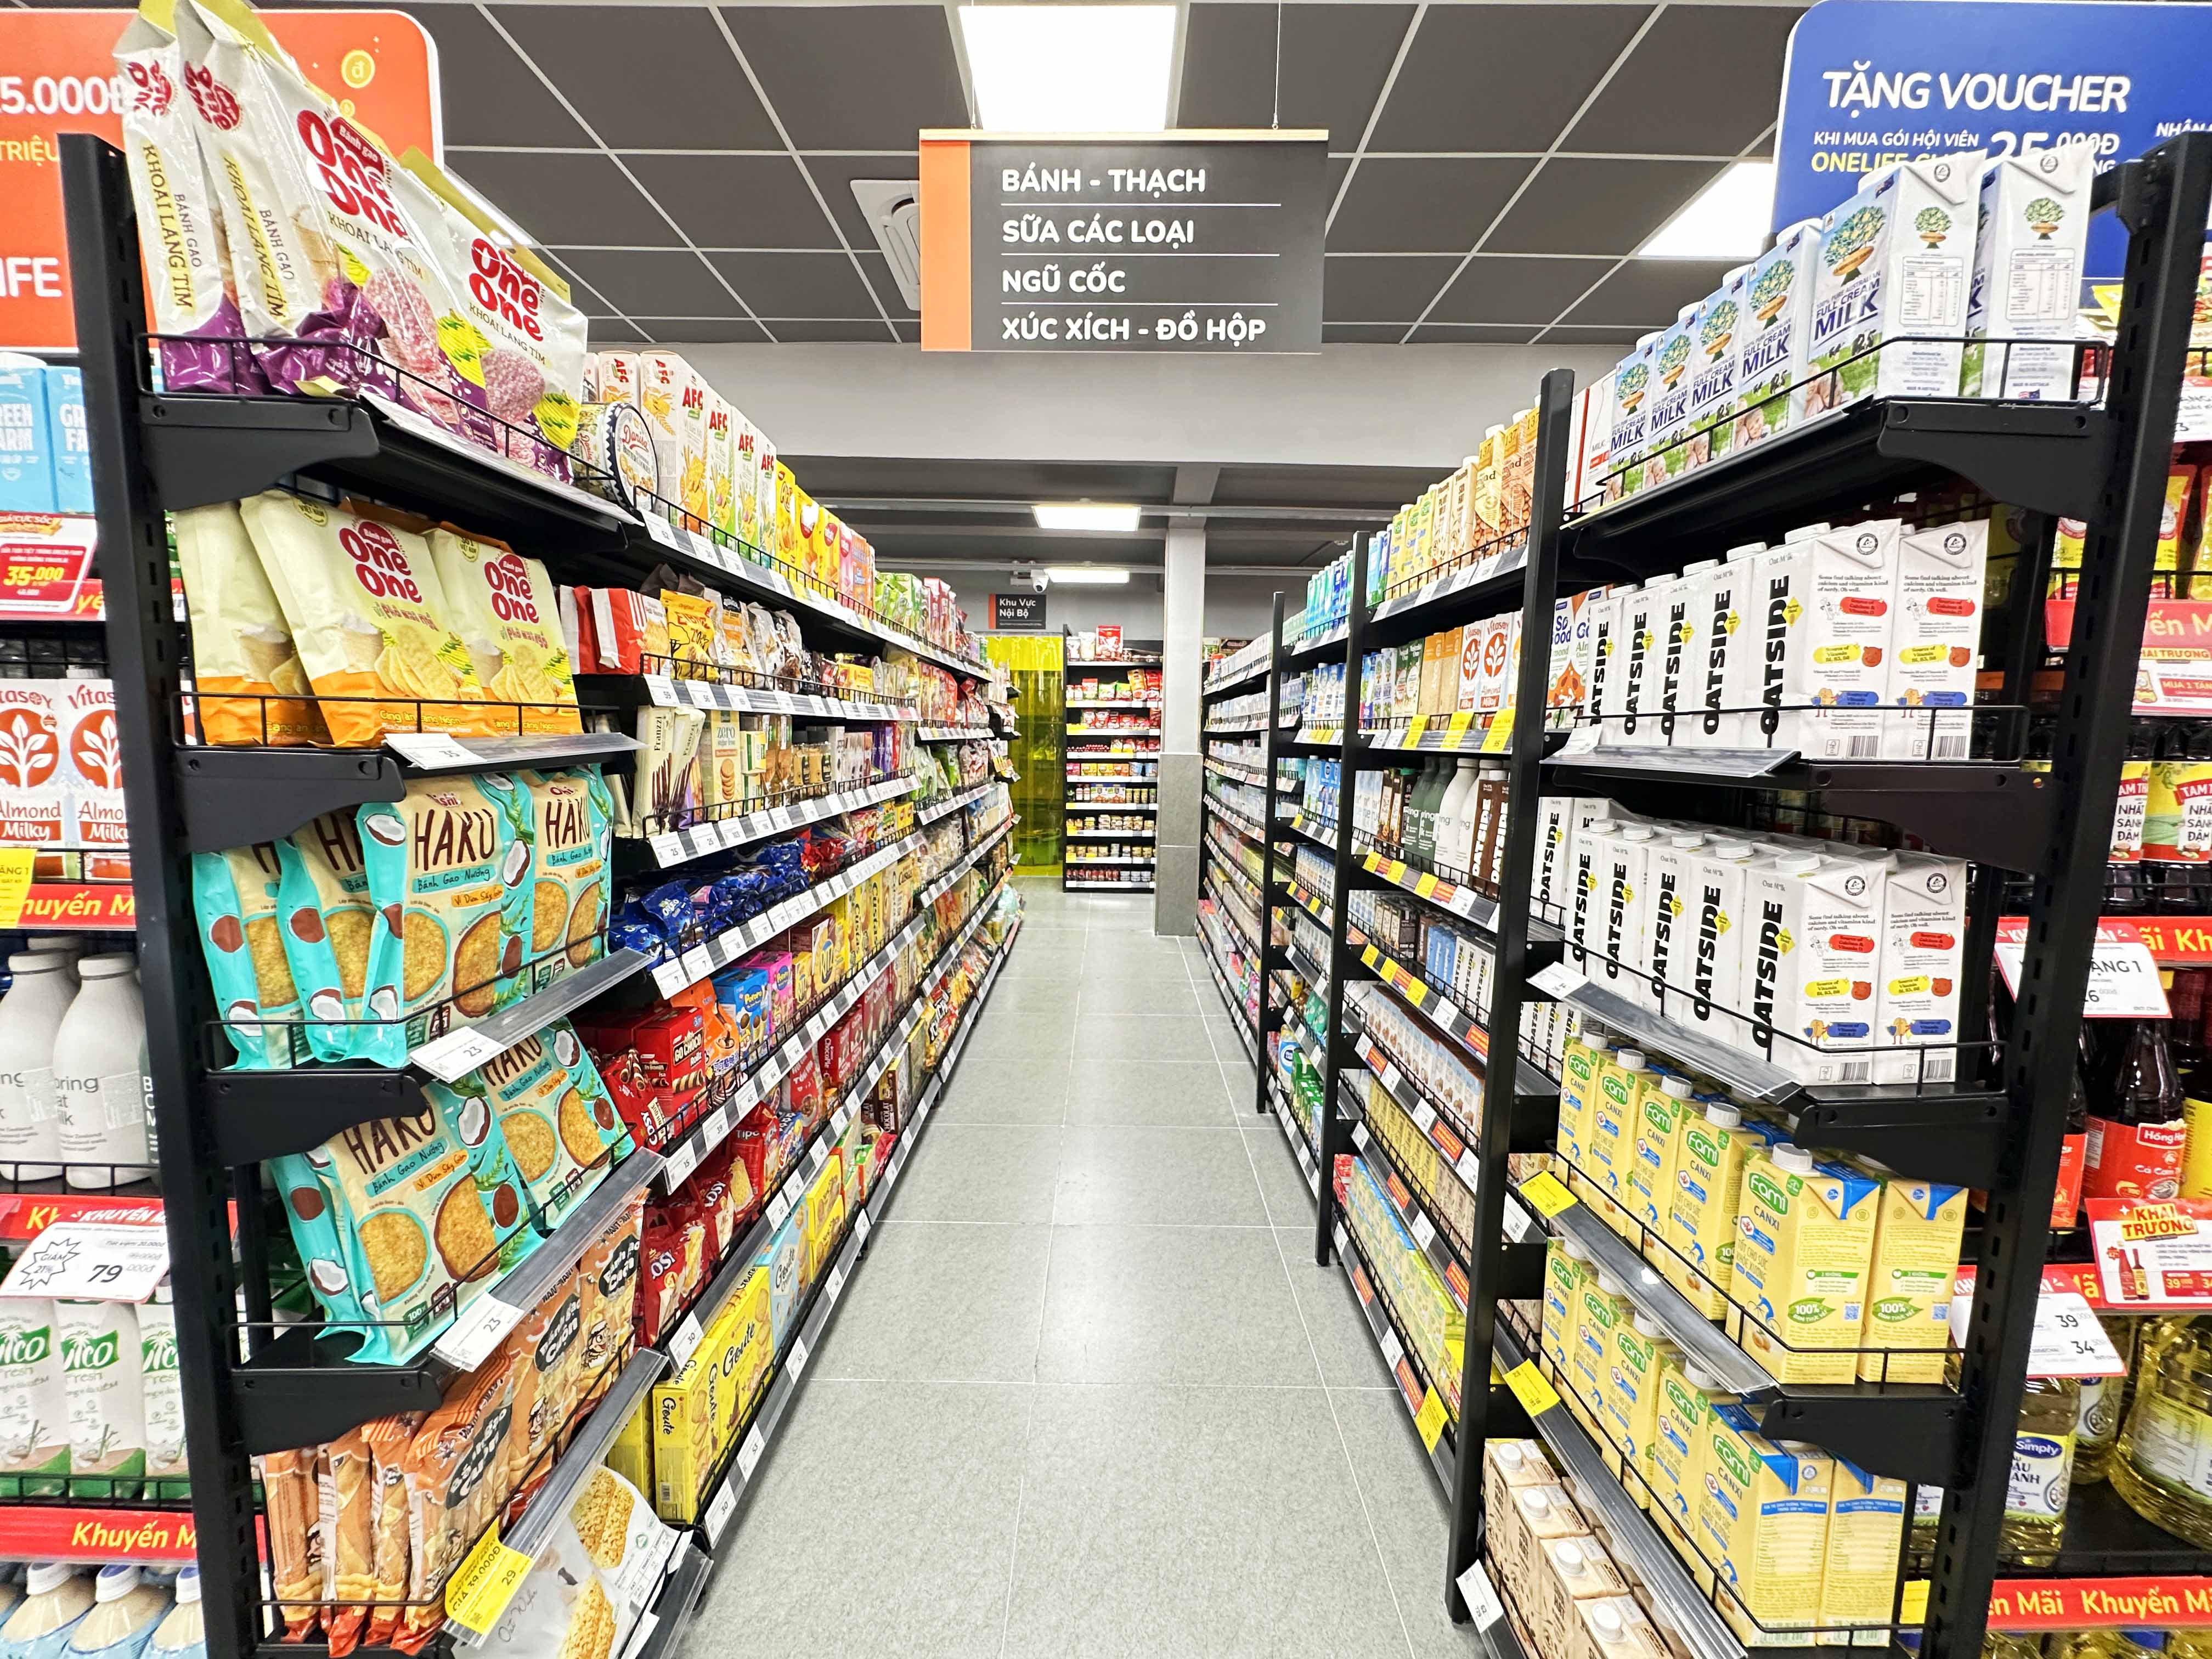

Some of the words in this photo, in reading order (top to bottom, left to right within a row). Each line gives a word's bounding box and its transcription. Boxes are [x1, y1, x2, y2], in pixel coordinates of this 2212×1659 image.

[1823, 60, 1931, 119] TẶNG
[1939, 74, 2131, 113] VOUCHER
[1814, 132, 1840, 146] KHI
[1843, 133, 1878, 146] MUA
[1882, 131, 1909, 148] GÓI
[1912, 129, 1934, 149] HỘI
[1938, 132, 1979, 148] VIÊN
[1002, 162, 1081, 193] BÁNH
[1108, 168, 1206, 199] THẠCH
[1002, 213, 1059, 244] SỮA
[1067, 213, 1123, 244] CÁC
[1130, 221, 1194, 249] LOẠI
[471, 238, 541, 314] One
[1002, 264, 1060, 292] NGŨ
[1069, 261, 1126, 292] CỐC
[469, 273, 543, 342] One
[1816, 301, 1838, 317] FULL
[1841, 279, 1881, 303] CREAM
[1002, 311, 1058, 341] XÚC
[1065, 311, 1129, 341] XÍCH
[1155, 309, 1198, 341] ĐỒ
[1206, 311, 1266, 347] HỘP
[1814, 289, 1878, 341] MILK
[1742, 334, 1790, 378] MILK
[1743, 344, 1762, 358] FULL
[1763, 324, 1791, 349] CREAM
[614, 358, 629, 383] AFC
[655, 359, 670, 384] AFC
[682, 386, 703, 408] AFC
[1691, 369, 1733, 407] MILK
[709, 410, 727, 432] AFC
[1650, 398, 1686, 432] MILK
[738, 432, 754, 453] AFC
[761, 453, 774, 472] AFC
[339, 527, 412, 575] One
[356, 563, 422, 603] One
[484, 561, 533, 600] One
[492, 592, 539, 624] One
[1000, 598, 1015, 606] Khu
[1019, 598, 1036, 608] Vực
[1000, 608, 1015, 618] Nội
[1017, 608, 1029, 619] Bộ
[1661, 602, 1685, 735] OATSIDE
[1703, 589, 1731, 735] OATSIDE
[1760, 574, 1790, 735] OATSIDE
[1624, 612, 1647, 736] OATSIDE
[1, 822, 50, 842] Milky
[545, 797, 591, 849] HAKU
[414, 808, 495, 871] HAKU
[1541, 812, 1560, 902] OATSIDE
[417, 878, 439, 893] Bánh
[1572, 853, 1591, 962] OATSIDE
[1606, 862, 1627, 979] OATSIDE
[1651, 872, 1676, 998] OATSIDE
[1693, 885, 1722, 1022] OATSIDE
[2133, 960, 2142, 973] 1
[1752, 900, 1783, 1048] OATSIDE
[463, 1046, 483, 1057] 23
[674, 1045, 686, 1063] GO
[684, 1034, 703, 1055] CHOCO
[1569, 1054, 1590, 1080] fami
[1570, 1077, 1585, 1093] CANXI
[1602, 1076, 1628, 1104] fami
[1605, 1101, 1622, 1118] CANXI
[1645, 1103, 1671, 1133] fami
[342, 1102, 436, 1175] HAKU
[1647, 1128, 1665, 1147] CANXI
[1688, 1131, 1718, 1166] fami
[372, 1173, 396, 1195] Bánh
[1690, 1159, 1711, 1181] CANXI
[1751, 1175, 1787, 1214] fami
[1753, 1205, 1780, 1231] CANXI
[2122, 1217, 2195, 1237] TRƯƠNG
[2135, 1205, 2176, 1221] KHAI
[87, 1265, 123, 1283] 79
[1551, 1257, 1573, 1289] fami
[1554, 1281, 1569, 1300] CANXI
[483, 1316, 501, 1333] 23
[1795, 1304, 1820, 1315] 100%
[1880, 1304, 1906, 1314] 100%
[2055, 1314, 2079, 1328] 39
[686, 1331, 697, 1345] 30
[1588, 1318, 1606, 1340] CANXI
[722, 1321, 757, 1379] Gouté
[1617, 1333, 1645, 1372] fami
[2070, 1340, 2095, 1355] 34
[1621, 1359, 1641, 1384] CANXI
[662, 1396, 676, 1436] Gouté
[1666, 1379, 1698, 1424] fami
[1670, 1408, 1692, 1437] CANXI
[1713, 1435, 1751, 1487] fami
[2016, 1439, 2061, 1457] Simply
[1718, 1465, 1742, 1500] CANXI
[720, 1500, 729, 1516] 30
[71, 1521, 168, 1553] Khuyến
[501, 1570, 517, 1586] 29
[2017, 1590, 2064, 1615] Mãi
[2081, 1585, 2179, 1620] Khuyến
